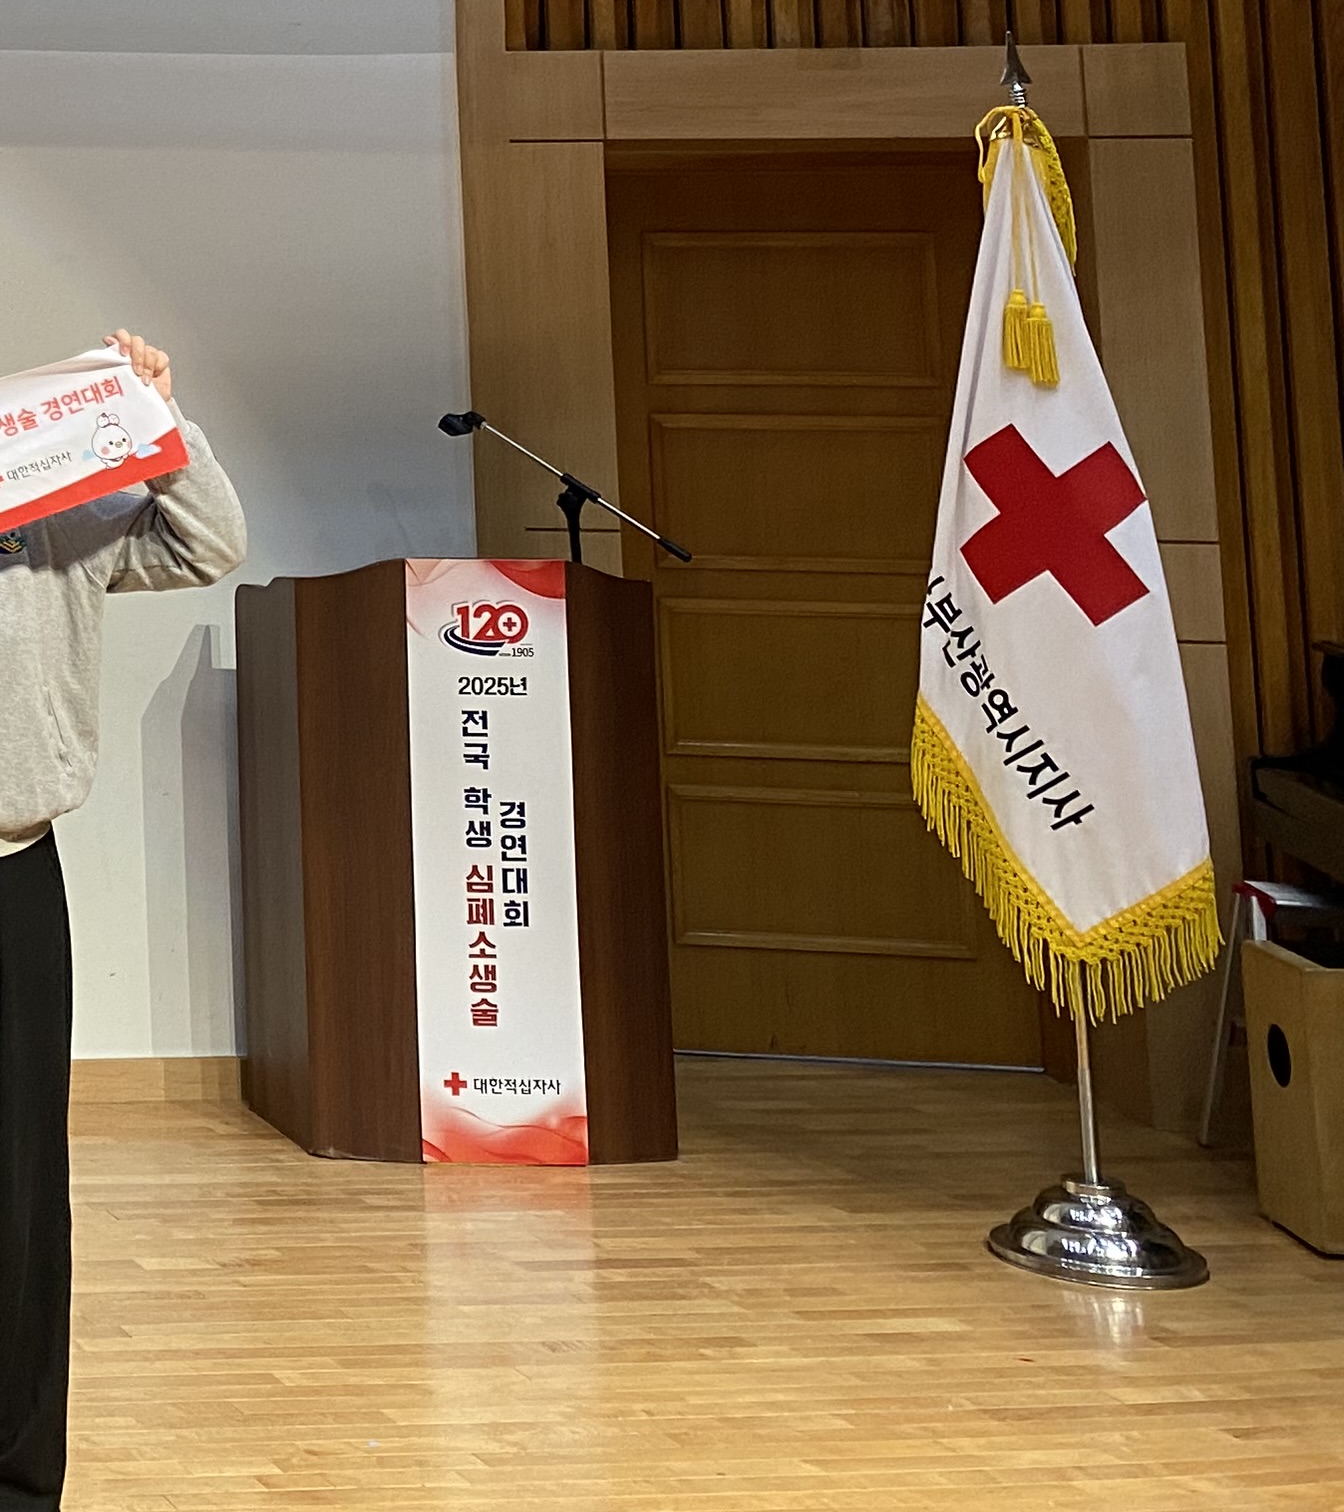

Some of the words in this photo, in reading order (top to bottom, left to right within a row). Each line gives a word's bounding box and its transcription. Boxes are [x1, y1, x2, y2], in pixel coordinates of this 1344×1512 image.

[40, 376, 126, 421] 경연대회
[6, 451, 73, 481] 대한적십자사
[512, 648, 534, 657] 1905
[459, 677, 527, 695] 2025년
[462, 710, 489, 769] 전국
[464, 787, 491, 847] 학생
[500, 802, 529, 927] 경연대회
[466, 865, 498, 1026] 심폐소생술
[473, 1077, 561, 1095] 대한적십자사
